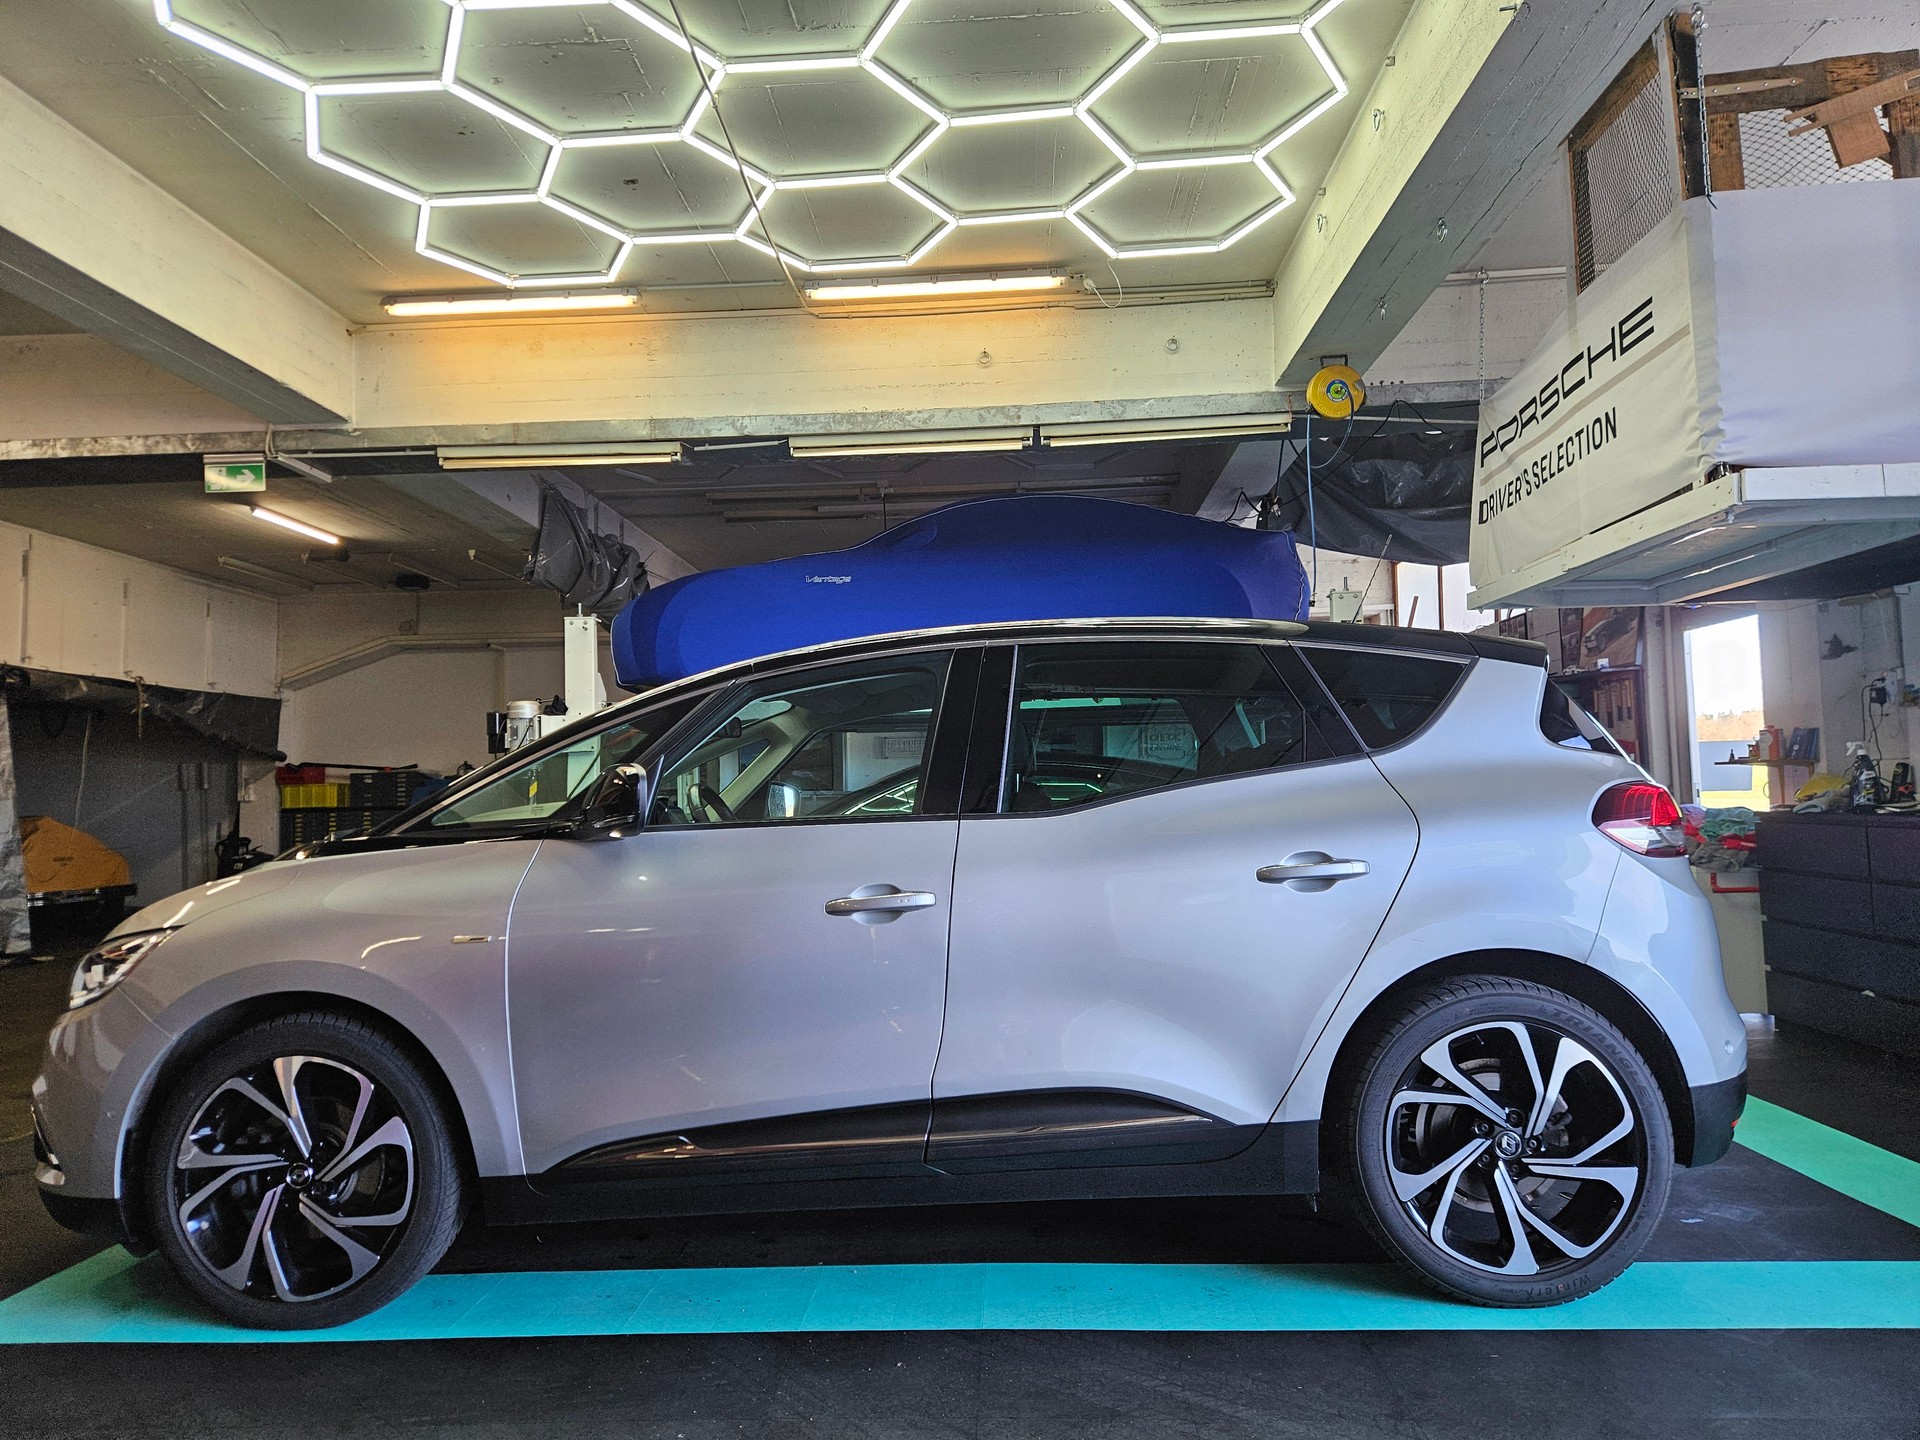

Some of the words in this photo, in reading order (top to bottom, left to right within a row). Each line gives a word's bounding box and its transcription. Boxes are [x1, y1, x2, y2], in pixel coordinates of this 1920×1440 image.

[1480, 296, 1655, 468] PORSCHE
[1478, 471, 1532, 525] DRIVER'S
[1533, 406, 1618, 490] SELECTION
[1550, 1008, 1652, 1100] TRIANGLE
